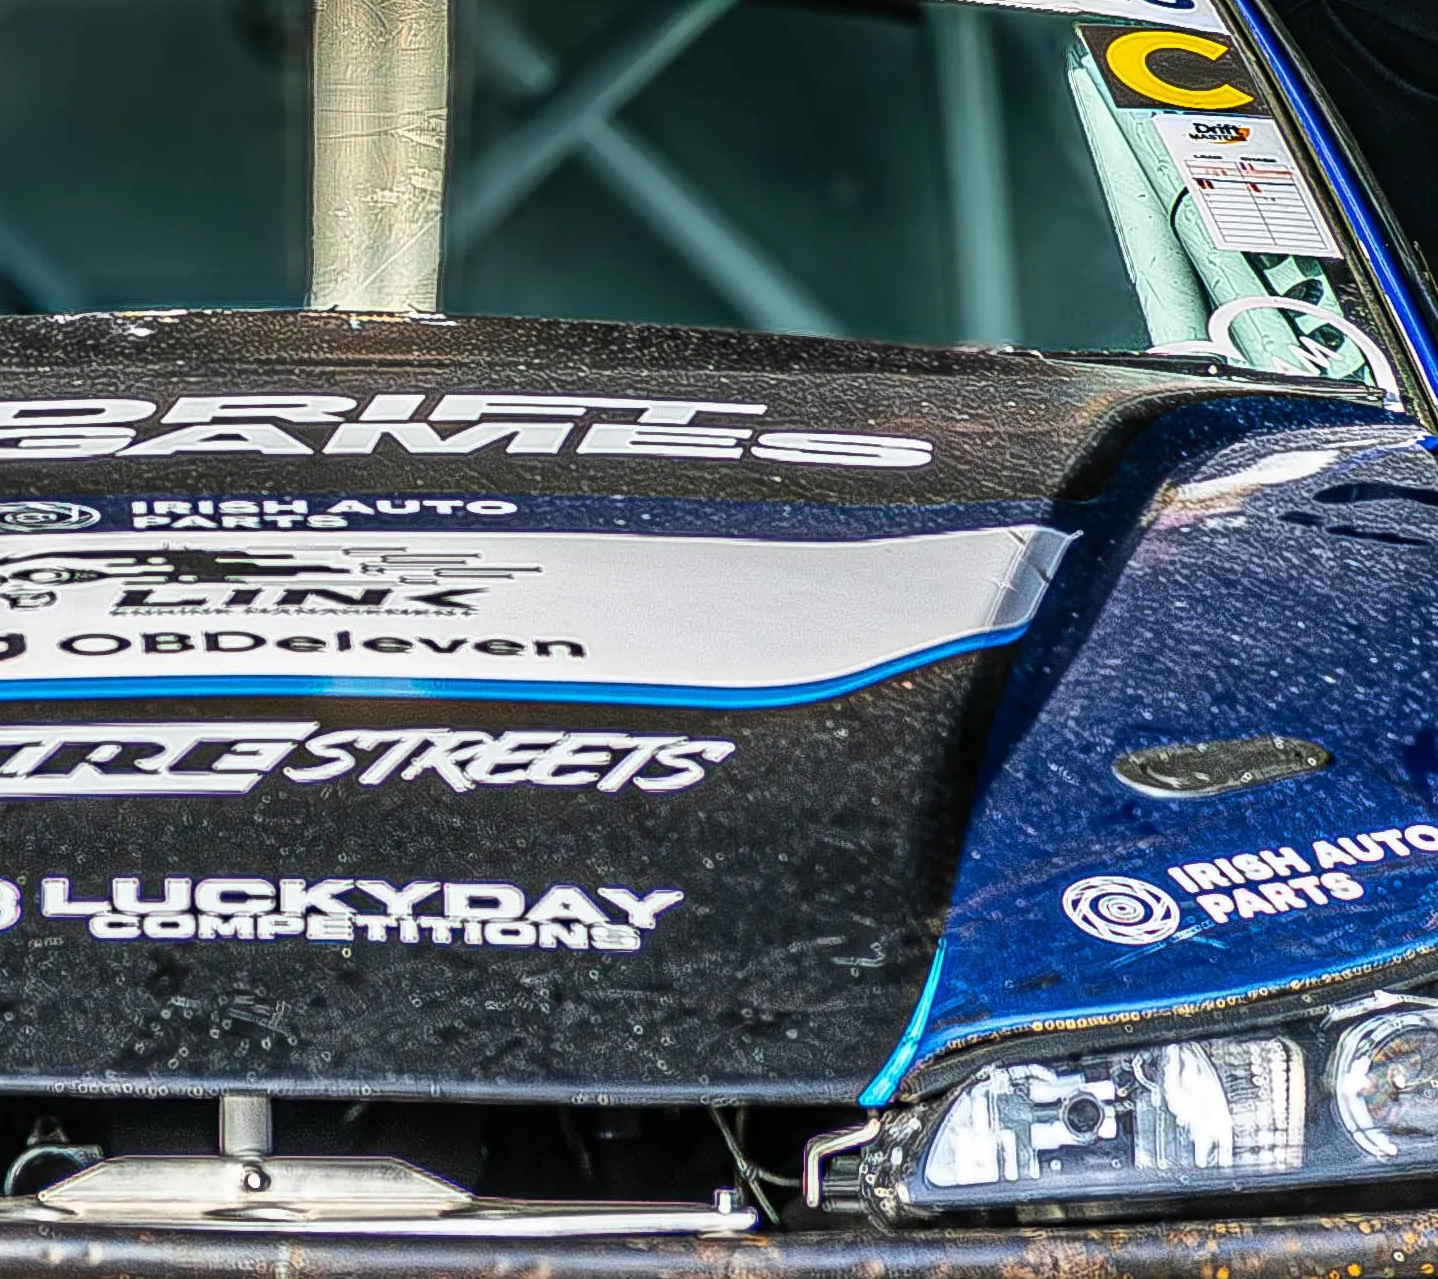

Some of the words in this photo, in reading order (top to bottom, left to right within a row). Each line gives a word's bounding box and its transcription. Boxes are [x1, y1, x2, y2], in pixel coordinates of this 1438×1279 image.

[1106, 31, 1254, 109] C
[131, 499, 309, 515] IRISH
[326, 498, 519, 516] AUTO
[131, 514, 349, 530] PARTS
[59, 630, 587, 659] OBDeleven
[282, 726, 736, 793] STREETS
[1166, 845, 1311, 895] IRISH
[41, 876, 685, 930] LUCKYDAY
[1195, 871, 1364, 924] PARTS
[88, 914, 643, 951] COMPETITIONS
